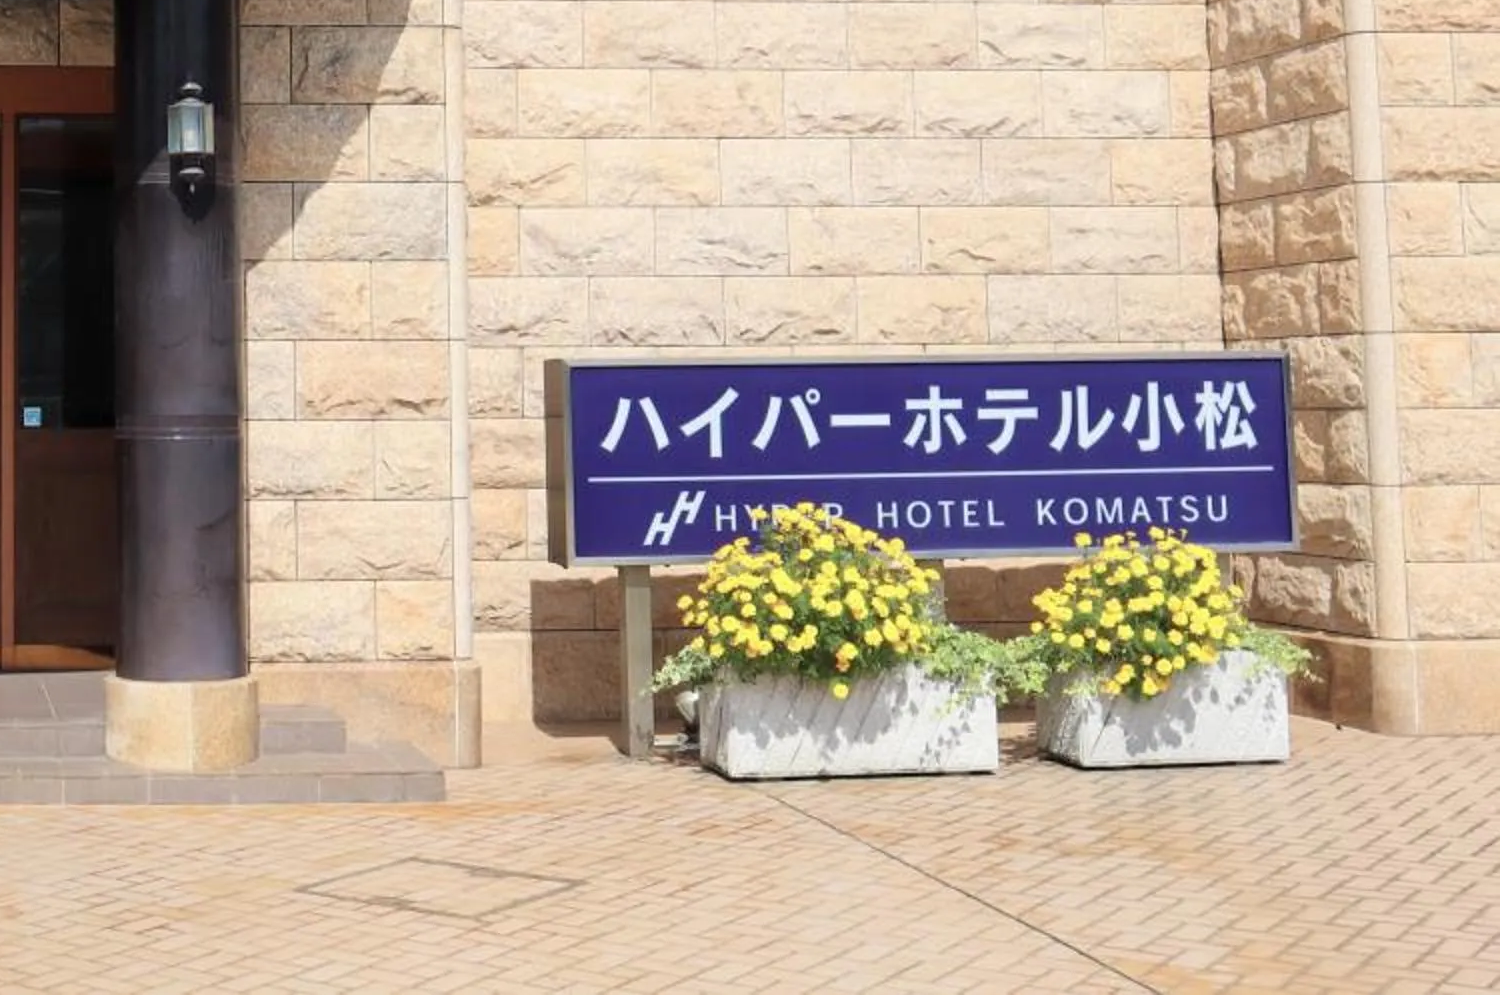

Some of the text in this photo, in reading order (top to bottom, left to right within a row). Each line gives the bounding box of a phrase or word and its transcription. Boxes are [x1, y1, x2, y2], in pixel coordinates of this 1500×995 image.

[601, 381, 1259, 458] ハイパーホテル小松
[878, 499, 1005, 529] HOTEL
[1037, 495, 1229, 526] KOMATSU
